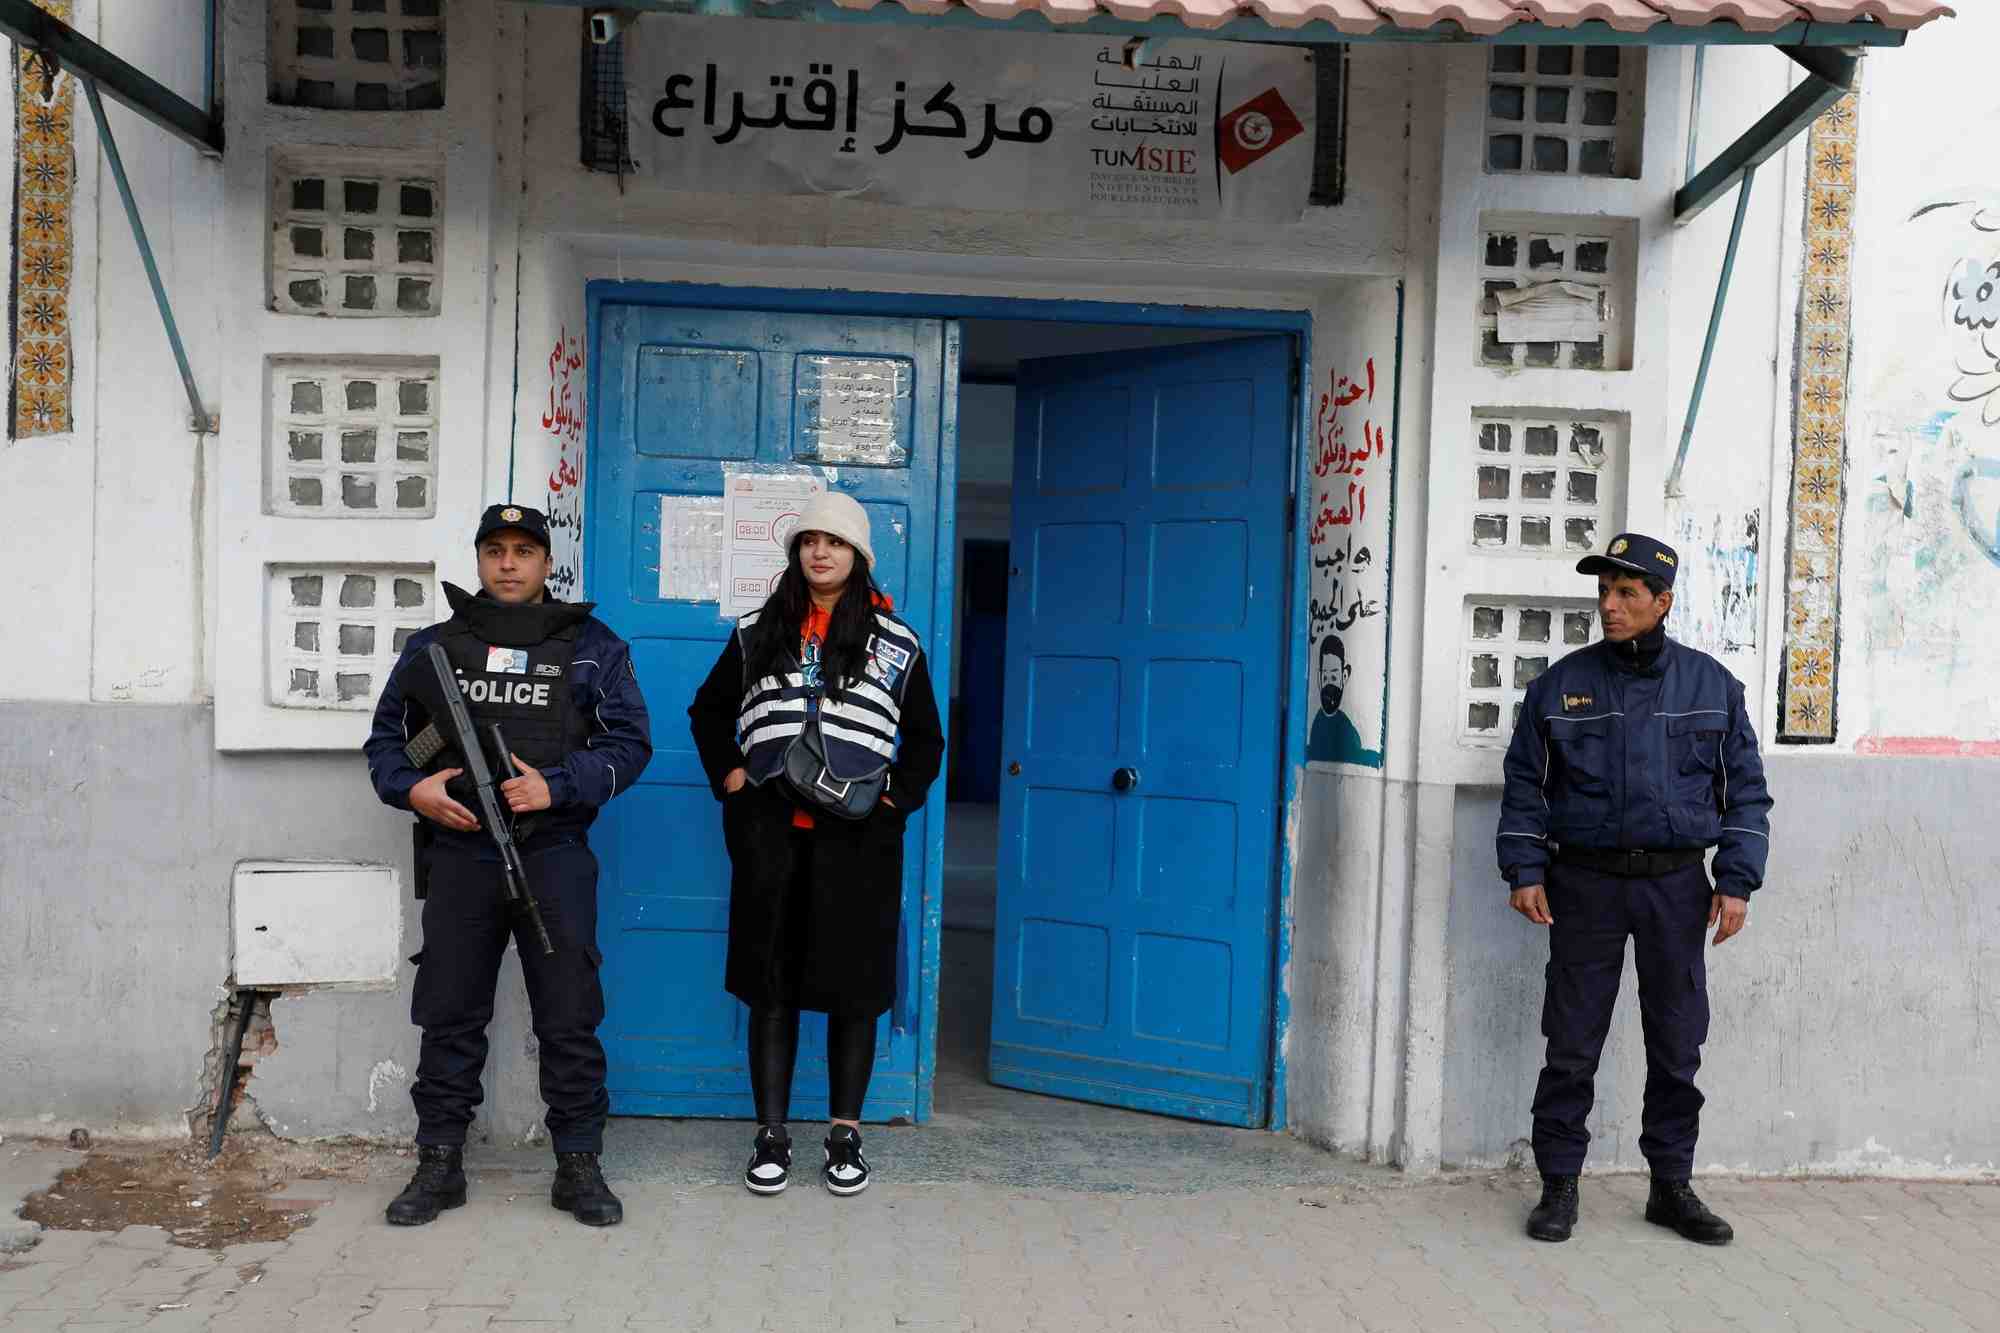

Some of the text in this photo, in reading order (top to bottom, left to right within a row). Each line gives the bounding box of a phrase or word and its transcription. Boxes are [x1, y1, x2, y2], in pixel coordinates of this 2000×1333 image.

[1094, 69, 1199, 94] العليا
[652, 63, 1053, 160] مركز إقتراع
[1092, 92, 1198, 116] المستقلة
[1090, 115, 1198, 136] للانتخابات
[458, 679, 551, 706] POLICE
